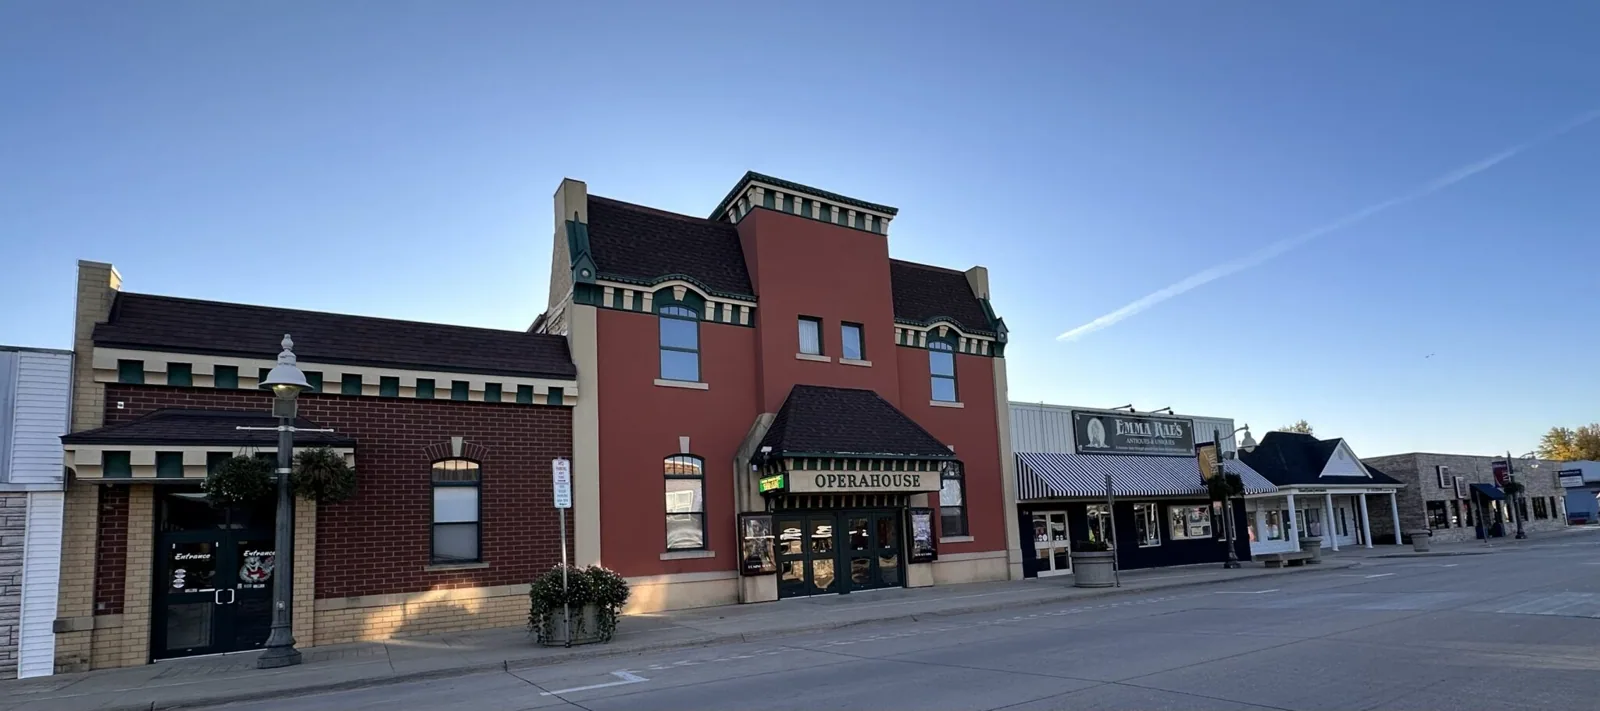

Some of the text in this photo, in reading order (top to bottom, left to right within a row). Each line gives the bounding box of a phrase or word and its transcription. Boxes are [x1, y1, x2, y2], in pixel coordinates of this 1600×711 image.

[1115, 419, 1183, 438] EMMA RAE'S
[815, 473, 921, 489] OPERAHOUSE
[174, 552, 211, 560] Entrance
[243, 549, 276, 557] Entrance
